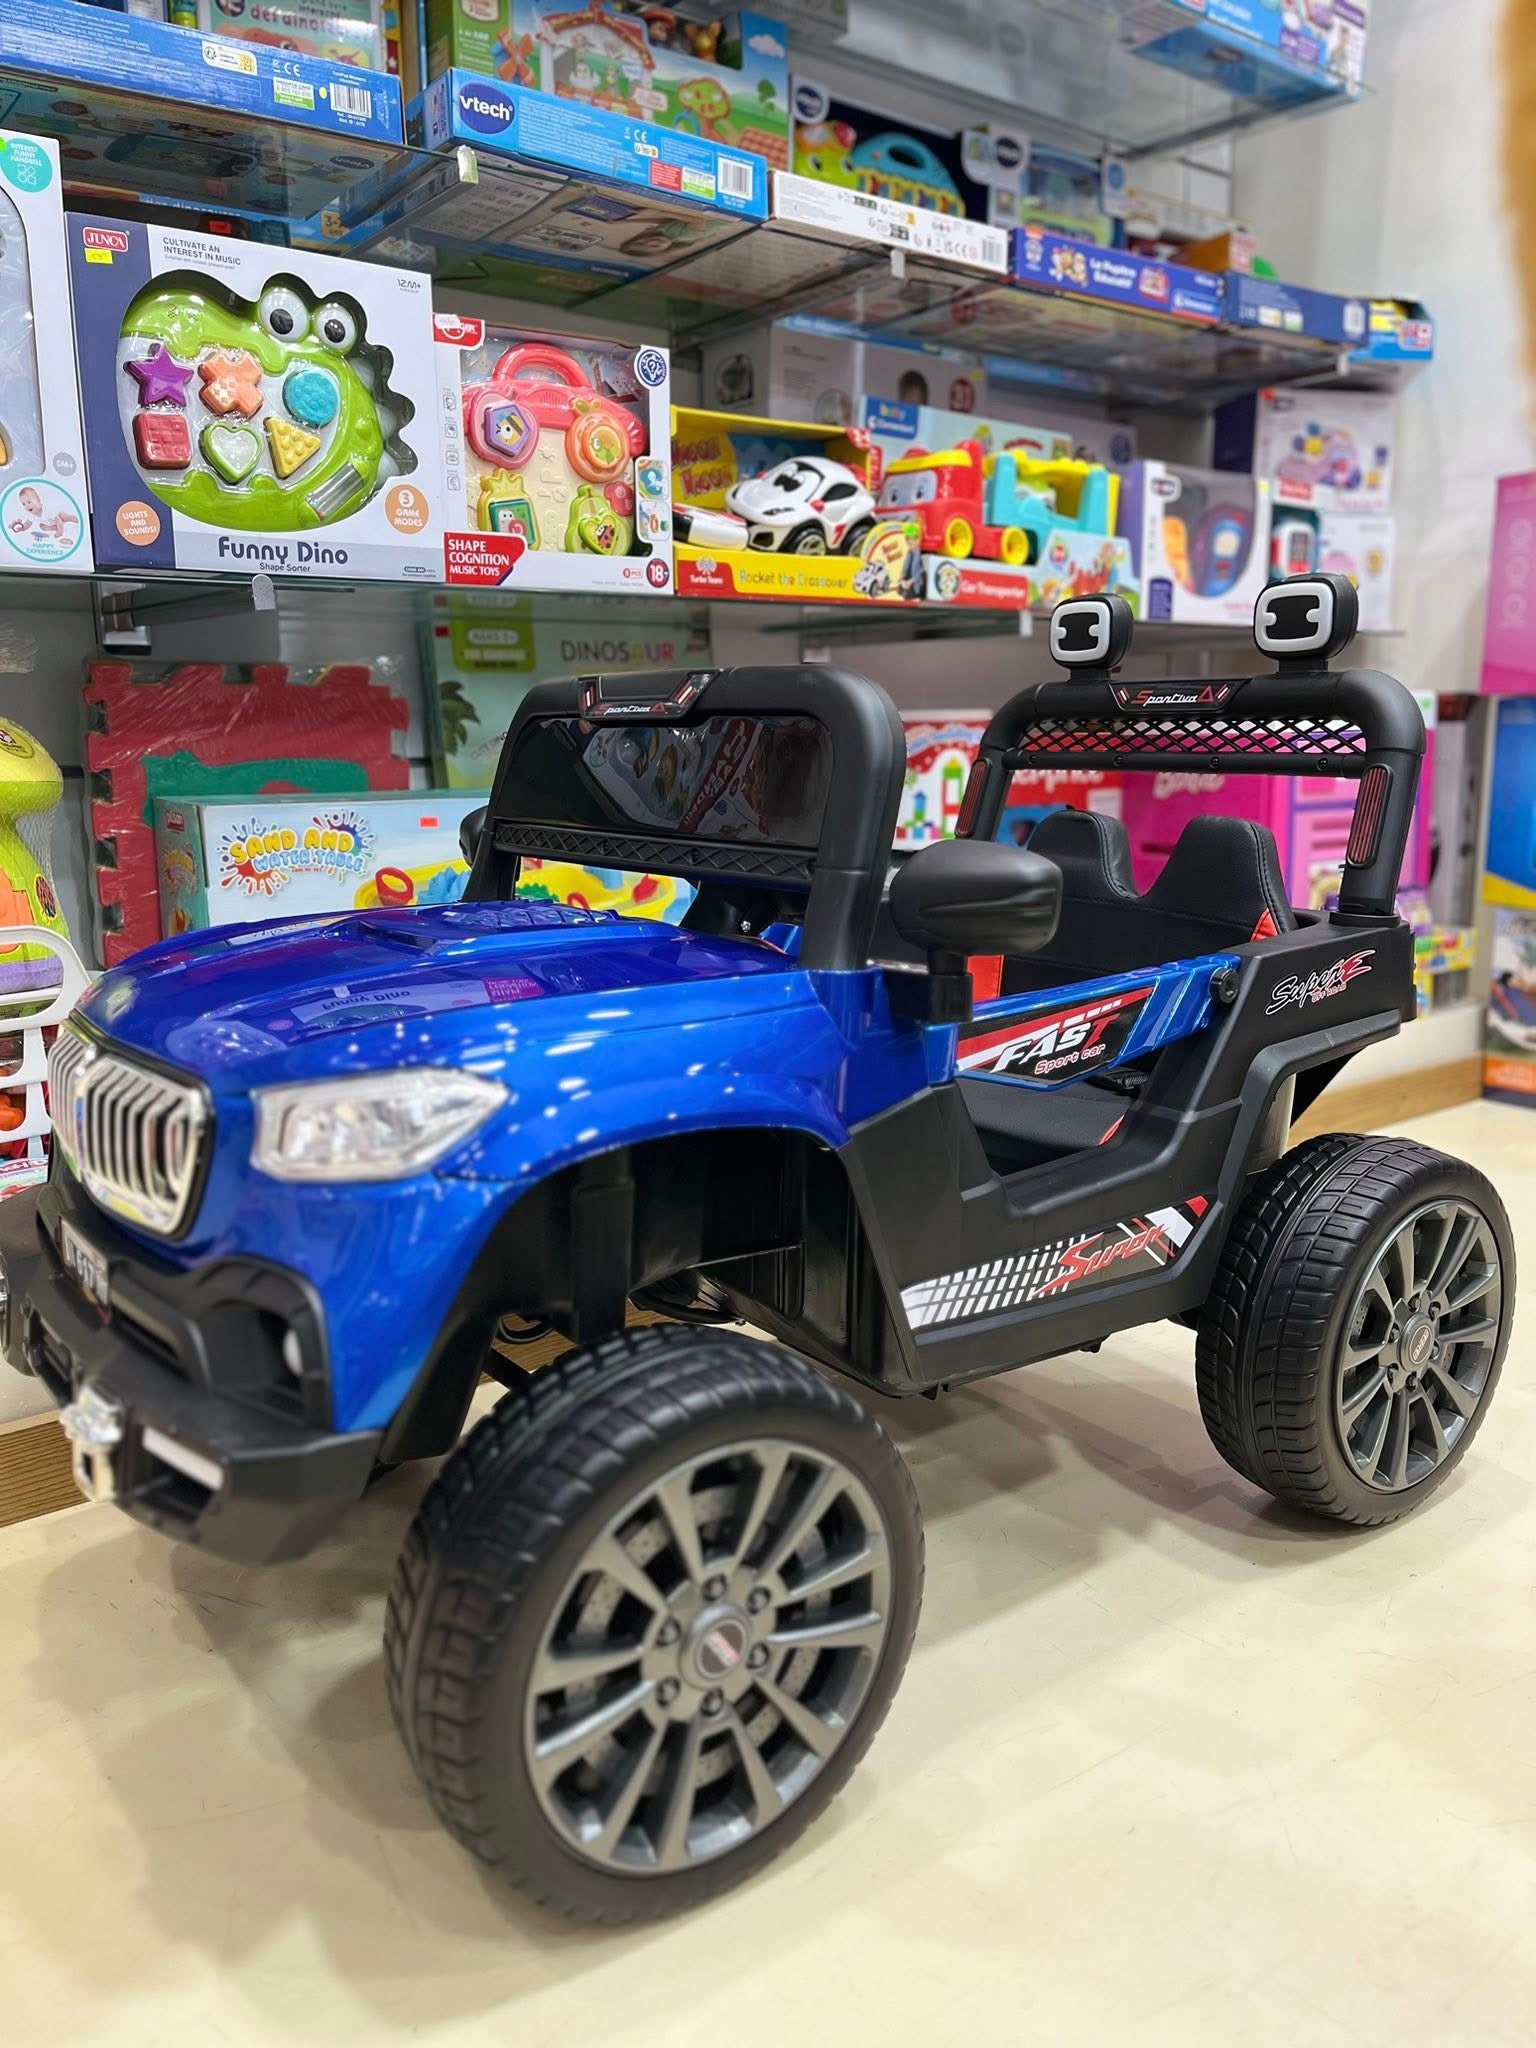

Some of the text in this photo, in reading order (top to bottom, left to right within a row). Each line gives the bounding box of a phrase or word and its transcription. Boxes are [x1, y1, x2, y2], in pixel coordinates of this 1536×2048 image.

[459, 94, 511, 121] vtech
[163, 236, 221, 254] CULTIVATE AN
[163, 246, 203, 259] INTEREST
[204, 252, 215, 261] IN
[216, 255, 241, 266] MUSIC
[401, 491, 411, 505] 3
[122, 511, 149, 521] LIGHTS
[395, 508, 421, 519] GAME
[130, 517, 147, 527] AND
[394, 516, 424, 528] MODES
[123, 526, 158, 537] SOUNDS!
[218, 536, 349, 566] Funny Dino
[448, 539, 487, 553] SHAPE
[448, 552, 510, 567] COGNITION
[259, 562, 311, 573] Shape Sorter
[449, 564, 478, 576] MUSIC
[479, 567, 501, 577] TOYS
[706, 576, 724, 585] Team
[739, 569, 775, 584] Rocket
[778, 571, 794, 585] the
[560, 640, 676, 663] DINOSAUR
[229, 828, 355, 864] SAND AND
[252, 849, 365, 873] WATER TABLE
[988, 1012, 1121, 1074] FAST
[1033, 1043, 1107, 1075] Sport car
